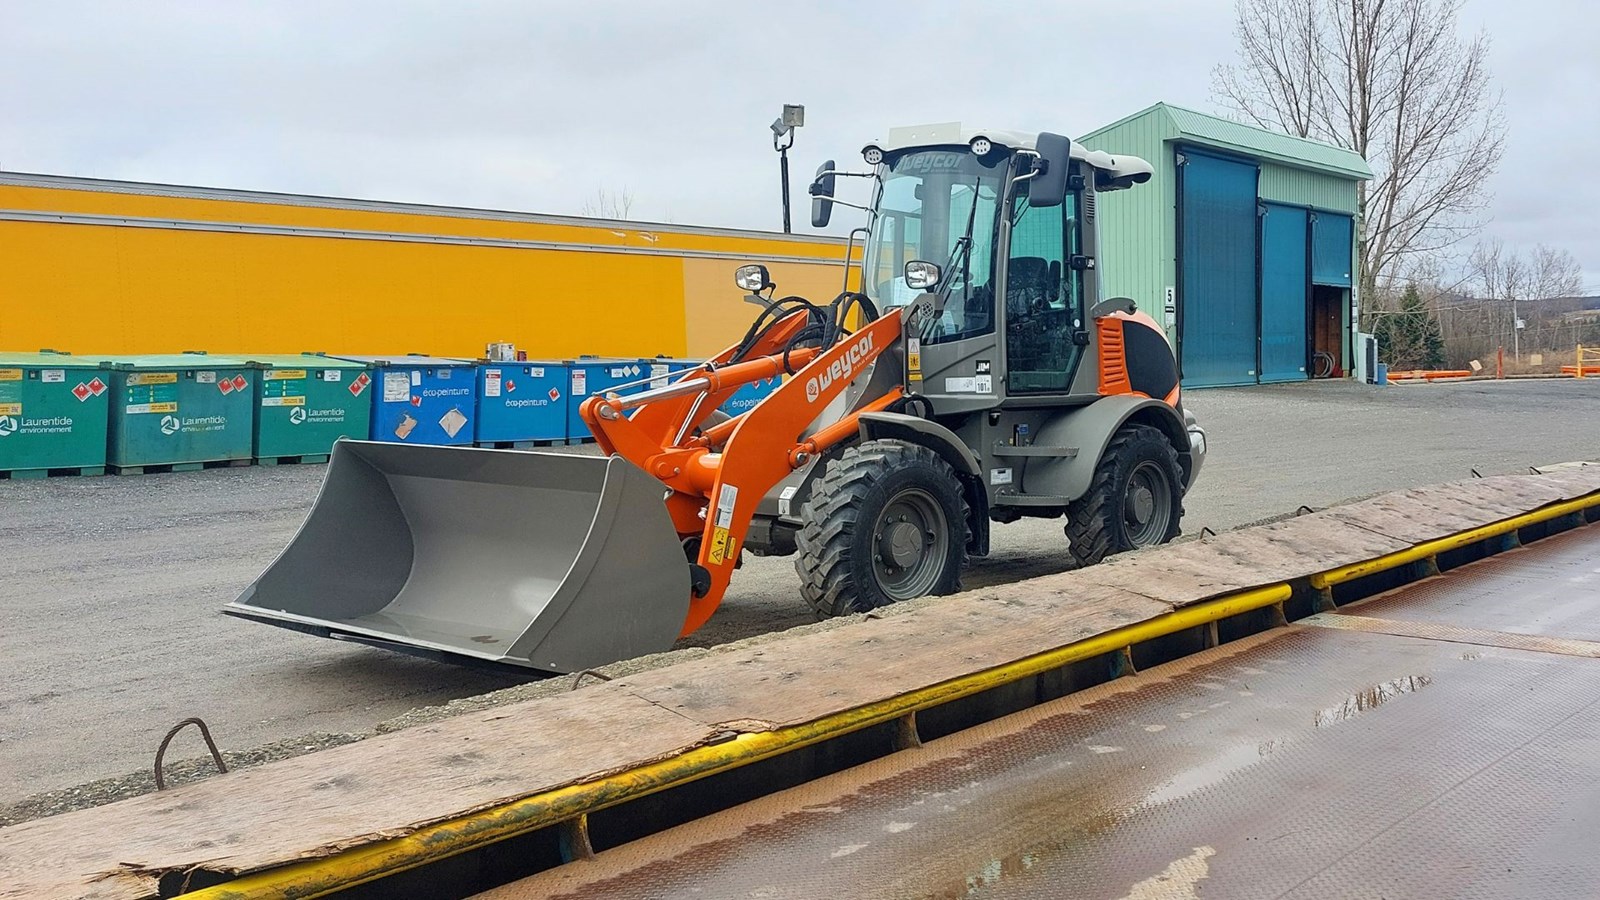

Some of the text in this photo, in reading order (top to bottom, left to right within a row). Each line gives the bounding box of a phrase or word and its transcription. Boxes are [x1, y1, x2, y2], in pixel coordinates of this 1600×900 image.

[902, 154, 964, 173] weycor
[1167, 289, 1172, 302] 5
[818, 330, 874, 392] weycor
[977, 382, 987, 392] 101
[308, 407, 345, 417] Laurentide
[21, 416, 73, 426] Laurentide
[182, 415, 226, 425] Laurentide
[20, 426, 72, 434] environnement
